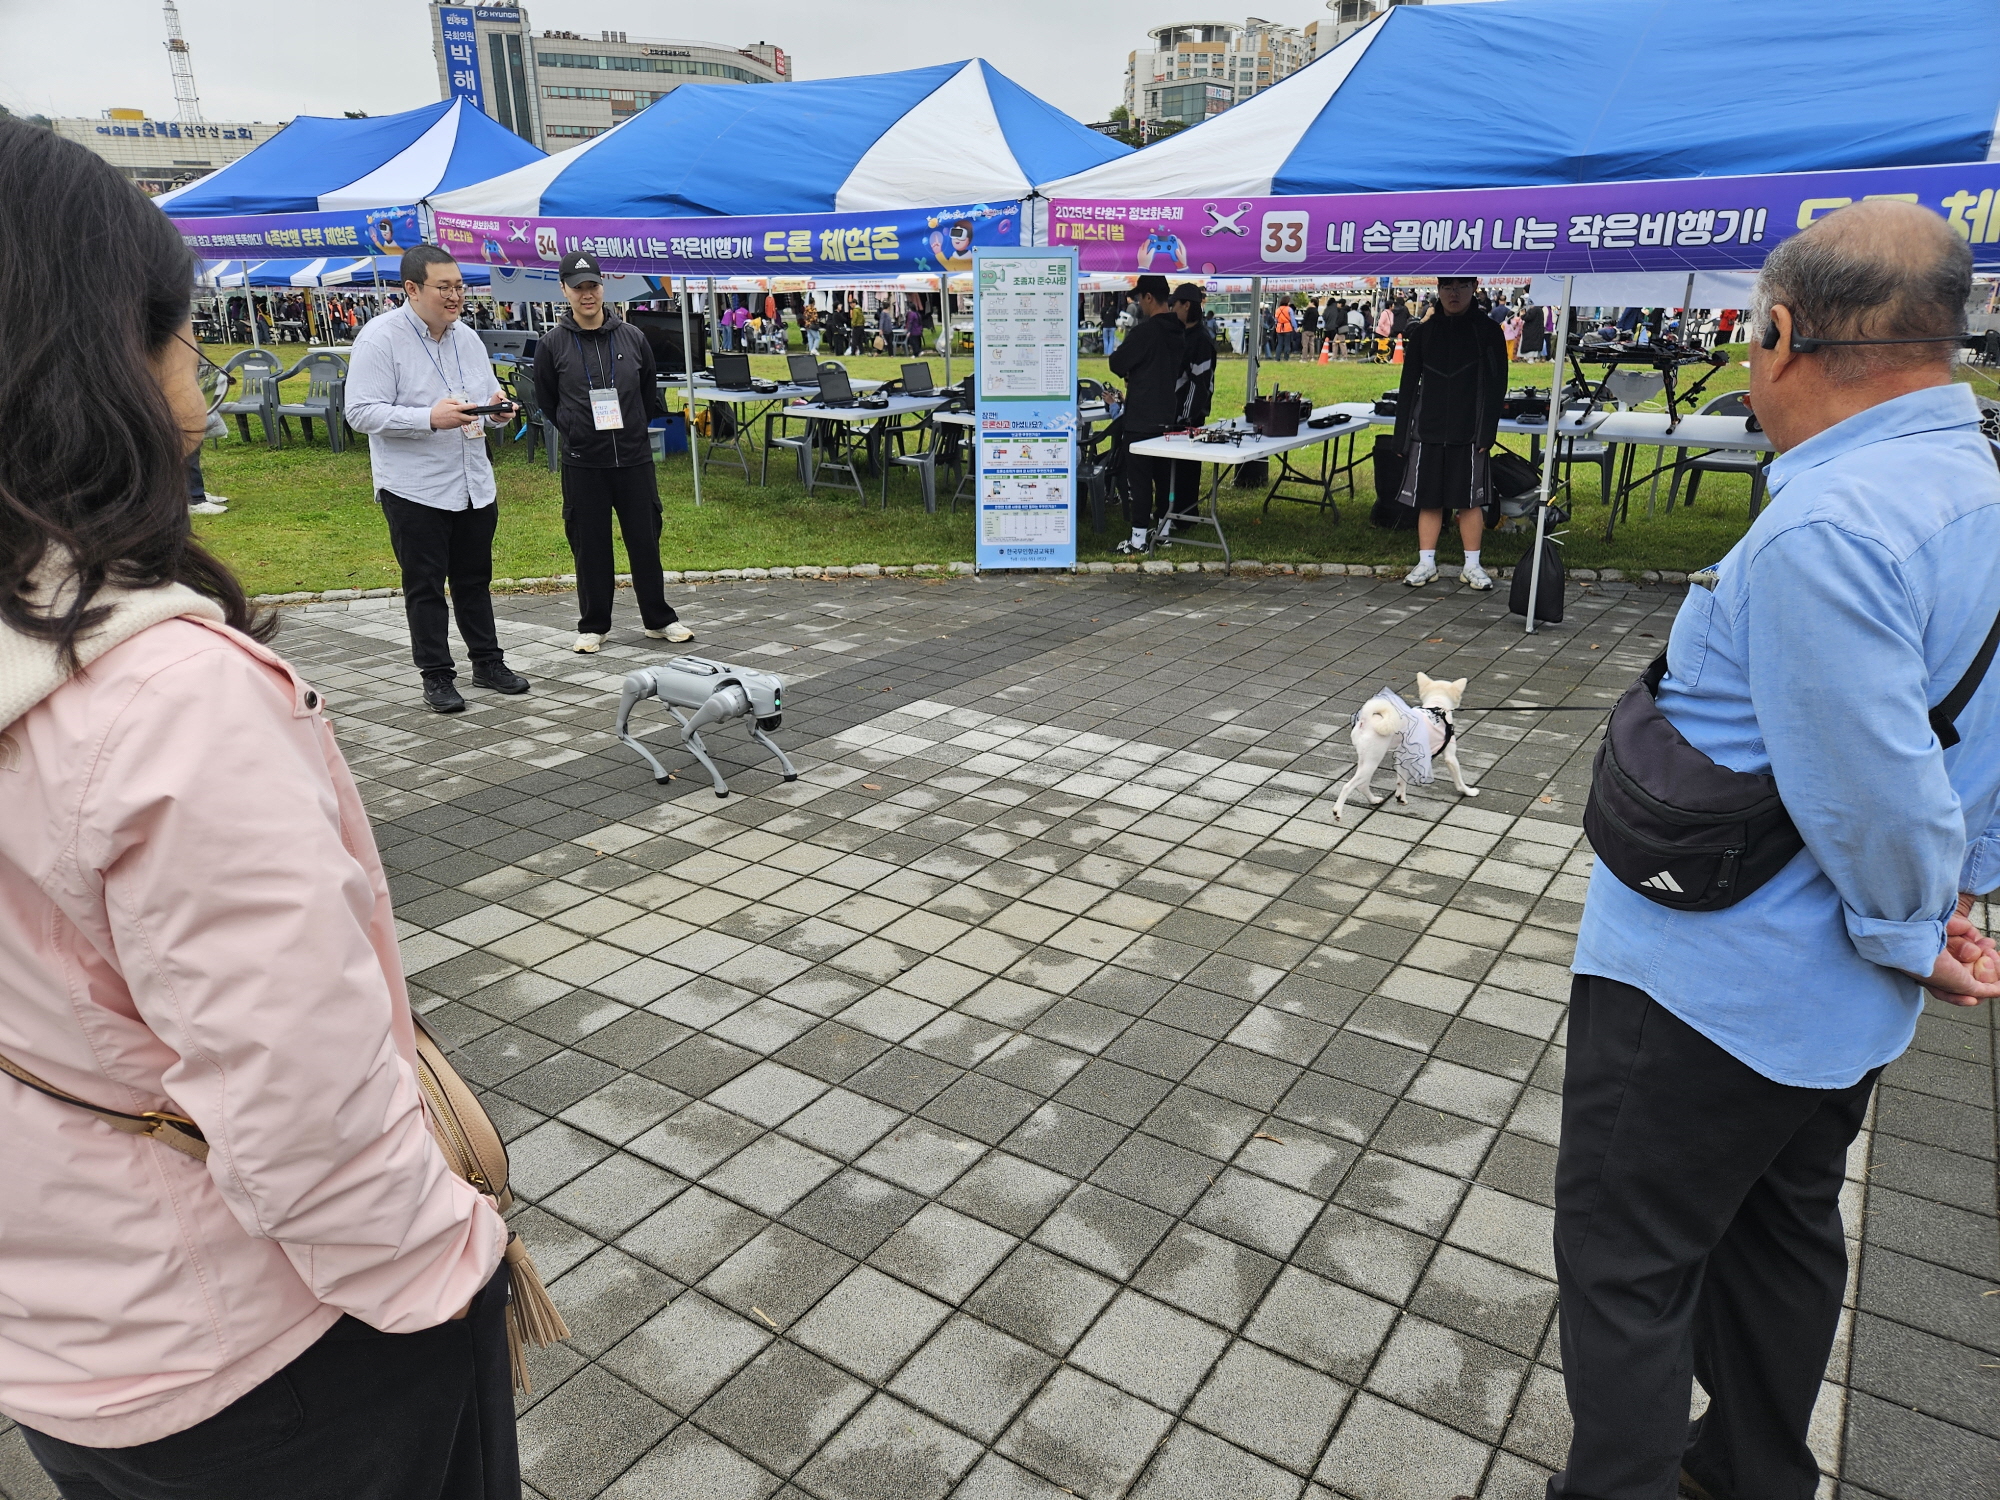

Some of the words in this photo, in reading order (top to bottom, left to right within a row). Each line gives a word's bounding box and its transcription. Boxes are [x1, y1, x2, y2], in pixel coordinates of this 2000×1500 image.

[446, 16, 469, 26] 민주당
[490, 11, 519, 19] HYUNDAI
[444, 30, 475, 42] 국회의원
[1055, 206, 1092, 220] 2025년
[1094, 206, 1127, 220] 단원구
[1128, 206, 1184, 221] 정보화축제
[211, 234, 237, 247] 로봇처럼
[264, 228, 301, 248] 4족보행
[301, 227, 324, 248] 로봇
[324, 225, 359, 246] 체험존
[439, 228, 447, 240] IT
[447, 229, 474, 243] 페스티벌
[1055, 223, 1070, 239] IT
[1071, 223, 1126, 242] 페스티벌
[1265, 221, 1303, 253] 33
[1327, 220, 1356, 254] 내
[1362, 217, 1483, 253] 손끝에서
[1490, 214, 1559, 250] 나는
[1567, 208, 1768, 249] 작은비행기!
[537, 234, 557, 256] 34
[565, 235, 578, 259] 내
[581, 236, 636, 259] 손끝에서
[638, 237, 669, 259] 나는
[671, 234, 753, 261] 작은비행기!
[763, 230, 814, 263] 드론
[818, 225, 900, 262] 체험존
[1047, 264, 1067, 276] 드론
[1013, 276, 1035, 286] 조종자
[1037, 276, 1067, 286] 준수사항
[1206, 282, 1217, 291] 20
[1320, 281, 1354, 291] 소떡소떡
[1487, 276, 1532, 286] 새우튀김세
[596, 414, 620, 424] STAFF
[981, 420, 1011, 429] 드론신고
[1011, 420, 1044, 429] 하셨나요?
